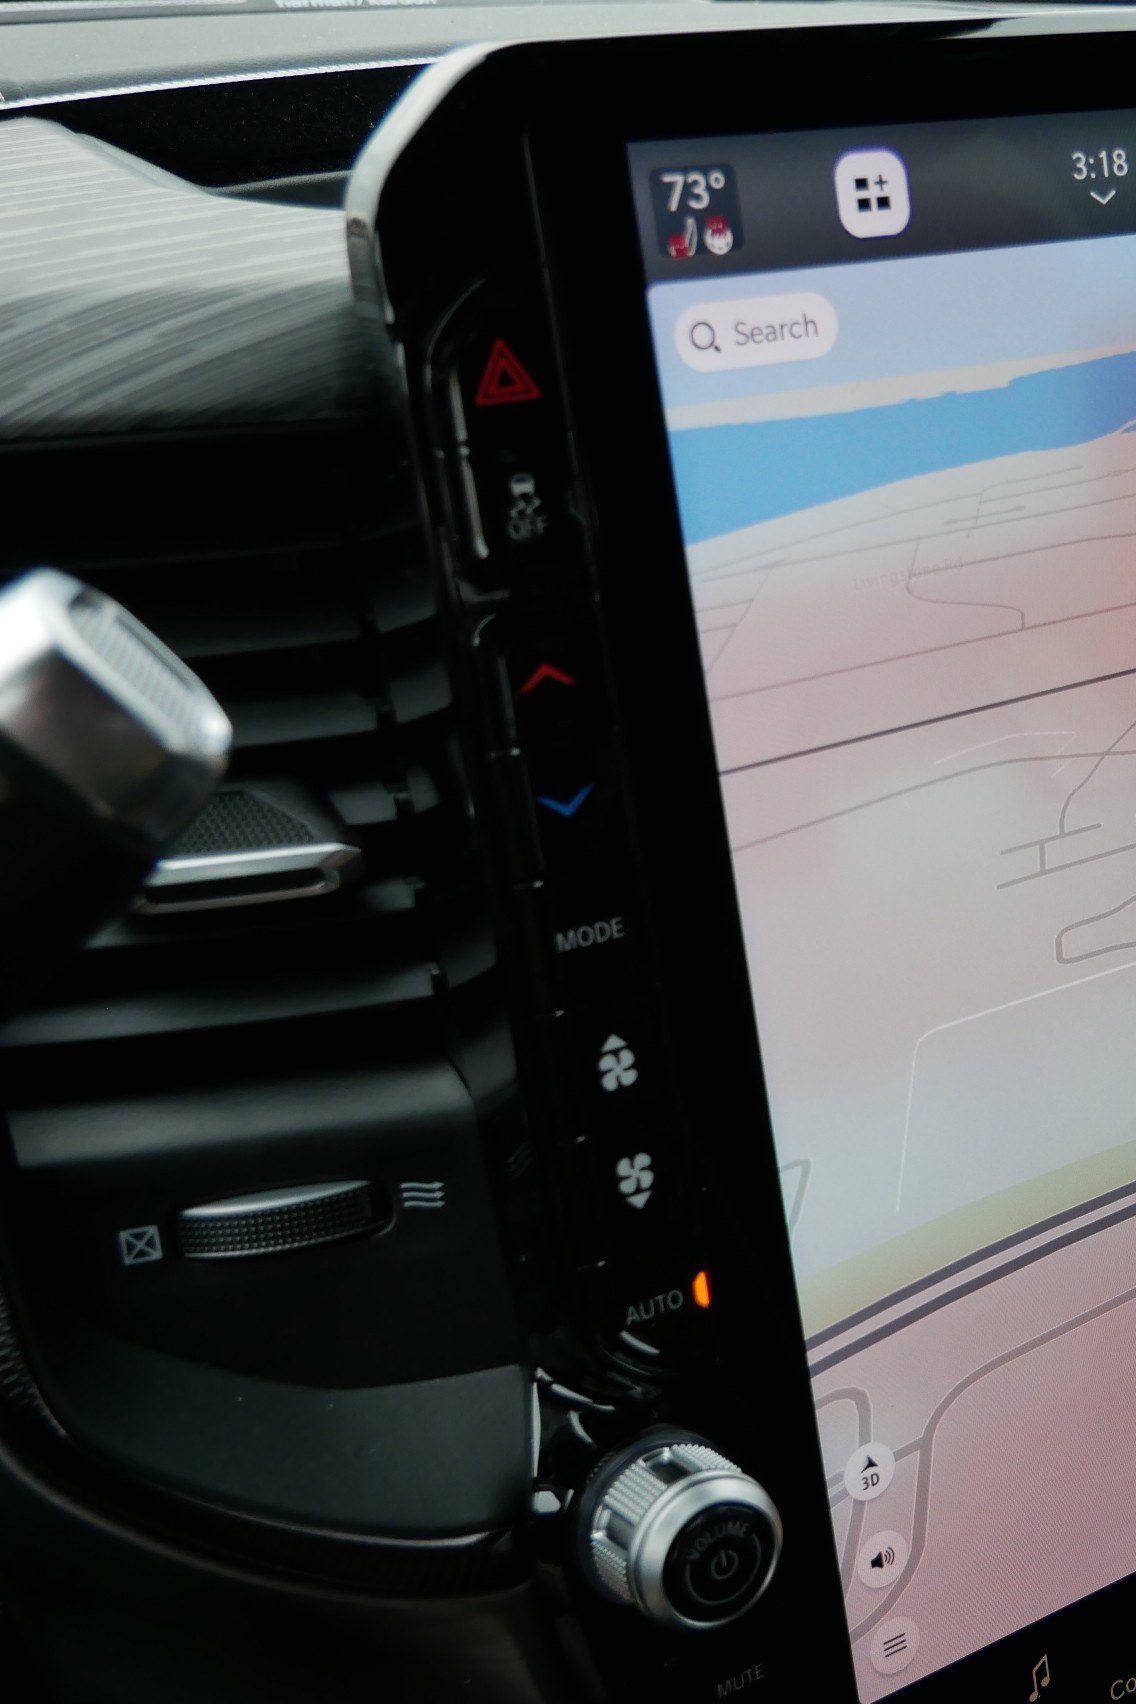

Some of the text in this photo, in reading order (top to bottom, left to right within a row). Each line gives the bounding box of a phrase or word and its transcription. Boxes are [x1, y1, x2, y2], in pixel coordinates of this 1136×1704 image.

[1070, 149, 1129, 180] 3:18
[659, 169, 726, 213] 73°
[733, 314, 819, 348] Search
[554, 916, 625, 953] MODE
[626, 1289, 684, 1325] AUTO
[861, 1472, 881, 1491] 3D
[687, 1521, 750, 1560] VOLUME
[716, 1663, 766, 1699] MUTE
